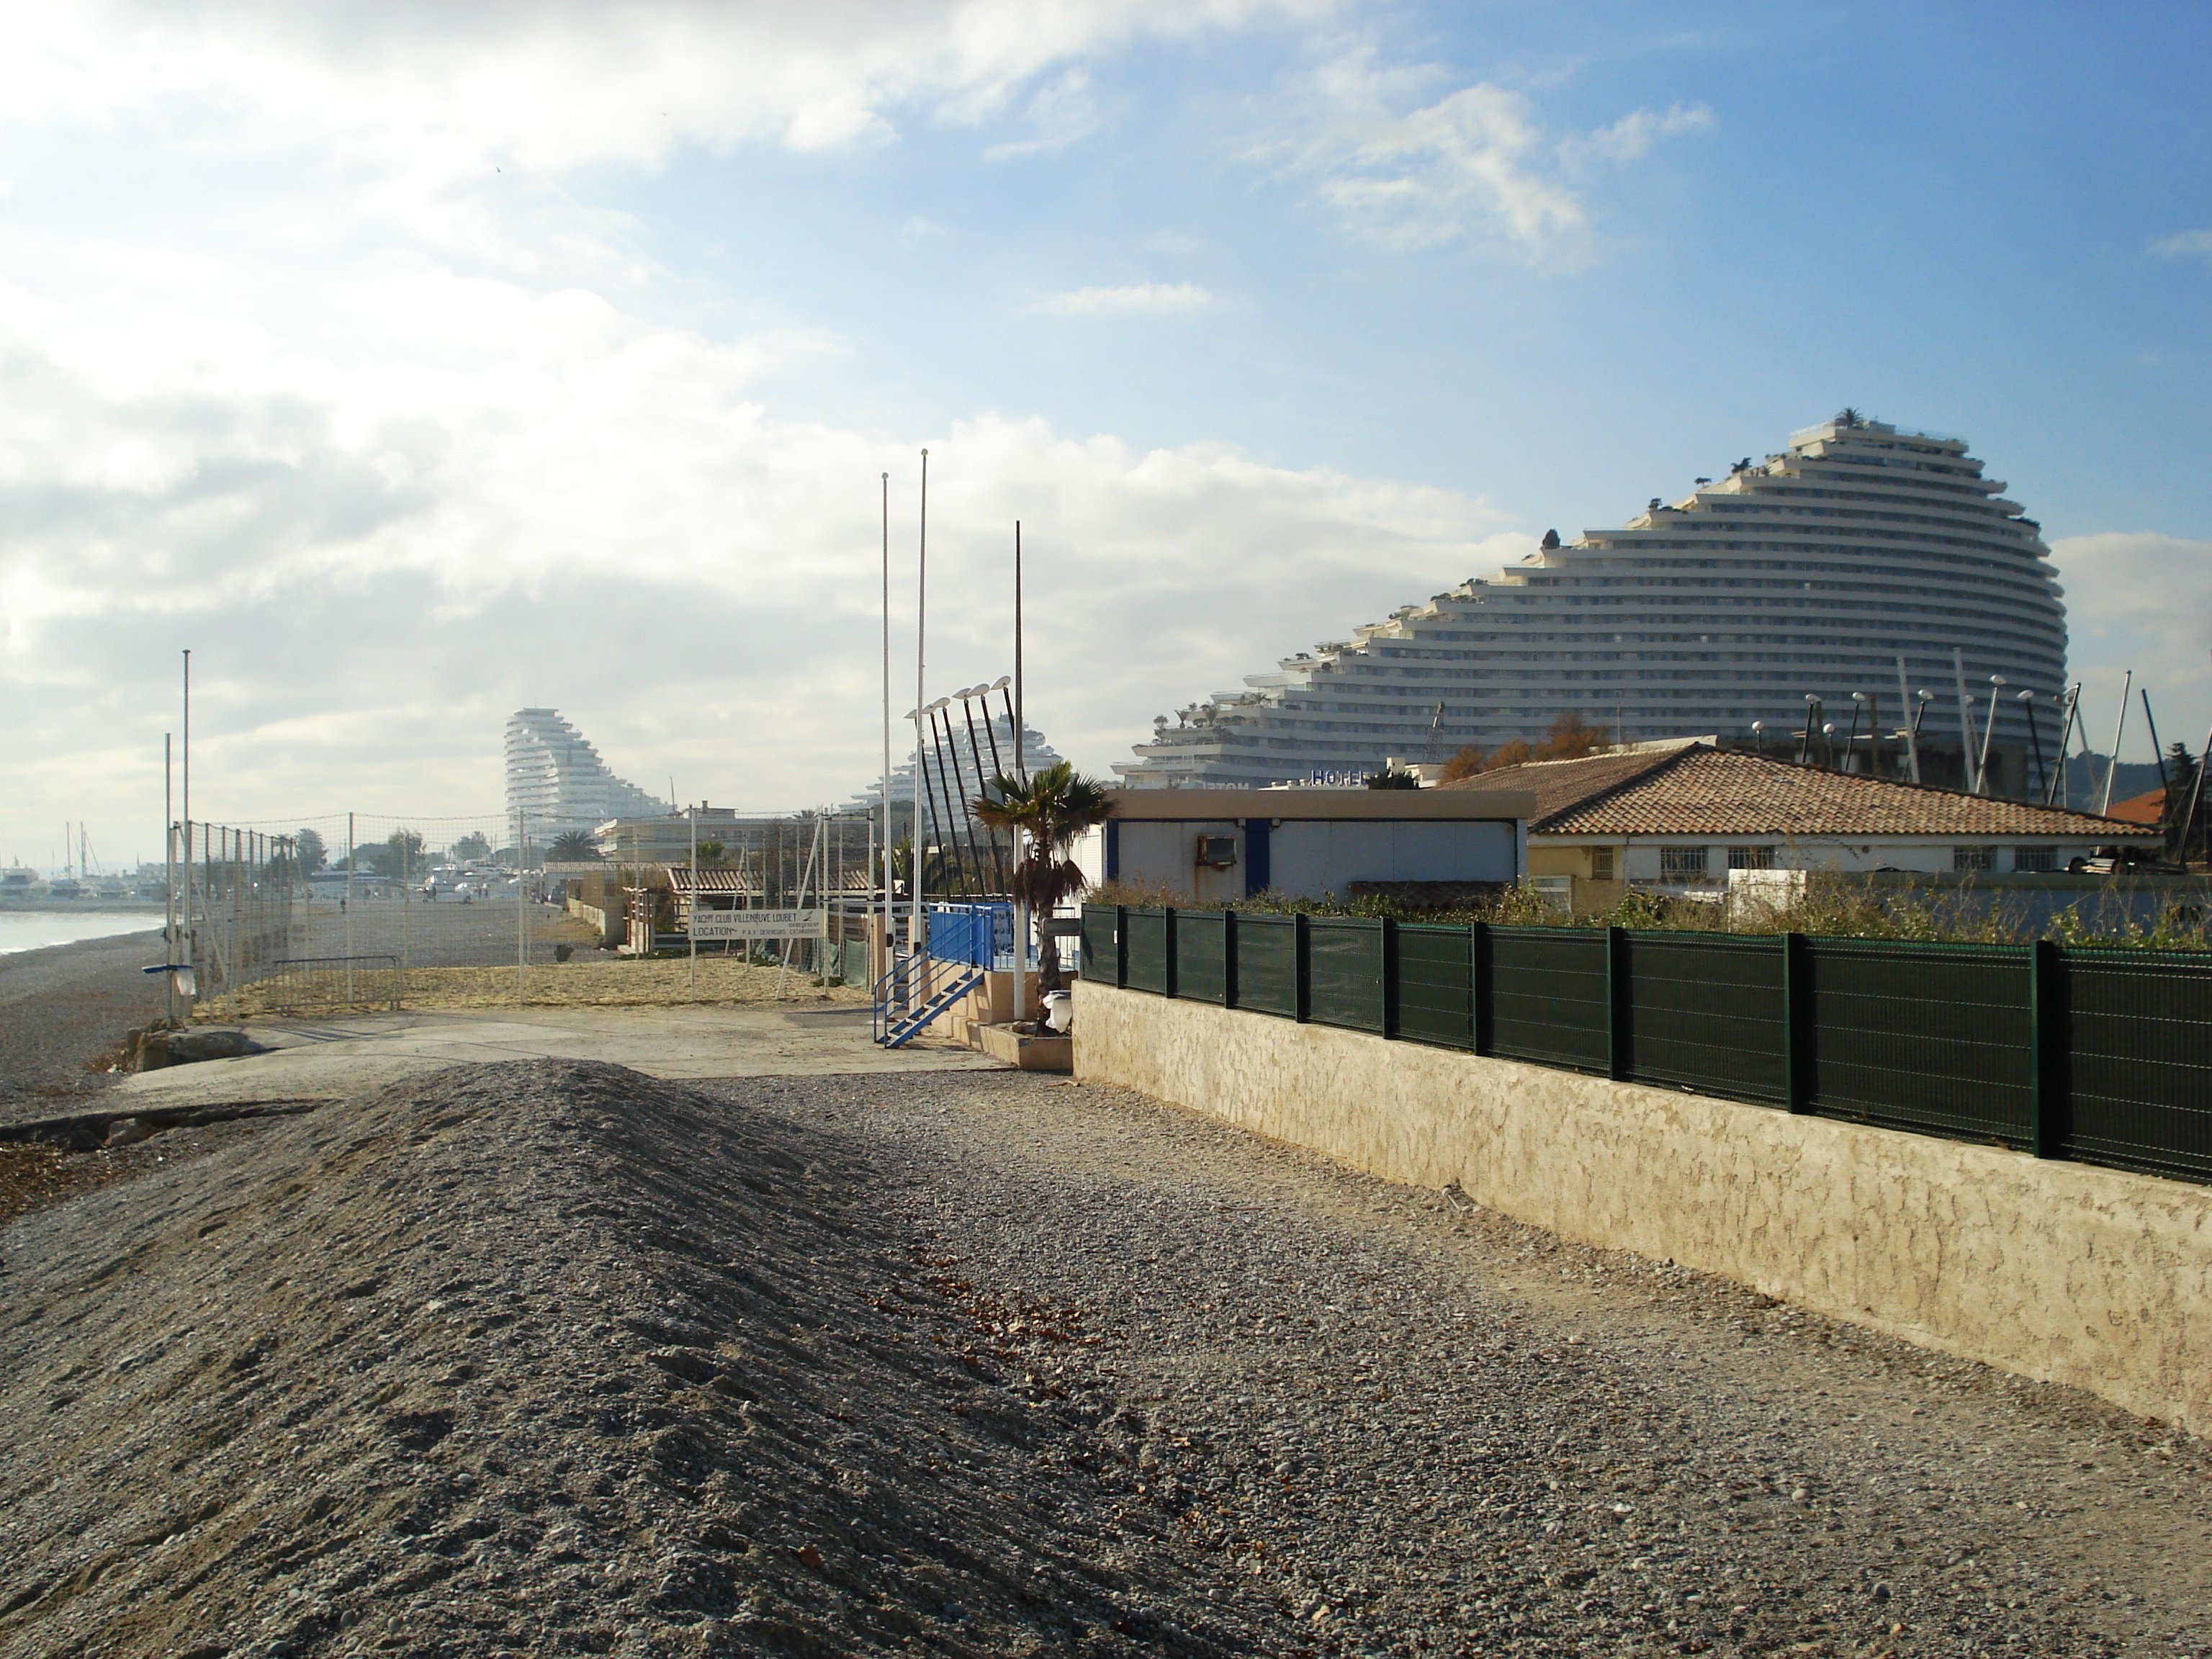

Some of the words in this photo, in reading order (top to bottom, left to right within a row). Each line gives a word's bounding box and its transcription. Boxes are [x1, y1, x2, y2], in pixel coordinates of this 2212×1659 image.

[1311, 770, 1368, 786] HOTEL
[693, 914, 714, 923] YACHT
[715, 914, 732, 923] CLUB
[733, 913, 771, 922] VILLENEUVE
[773, 913, 796, 922] LOUBET
[693, 927, 732, 937] LOCATION
